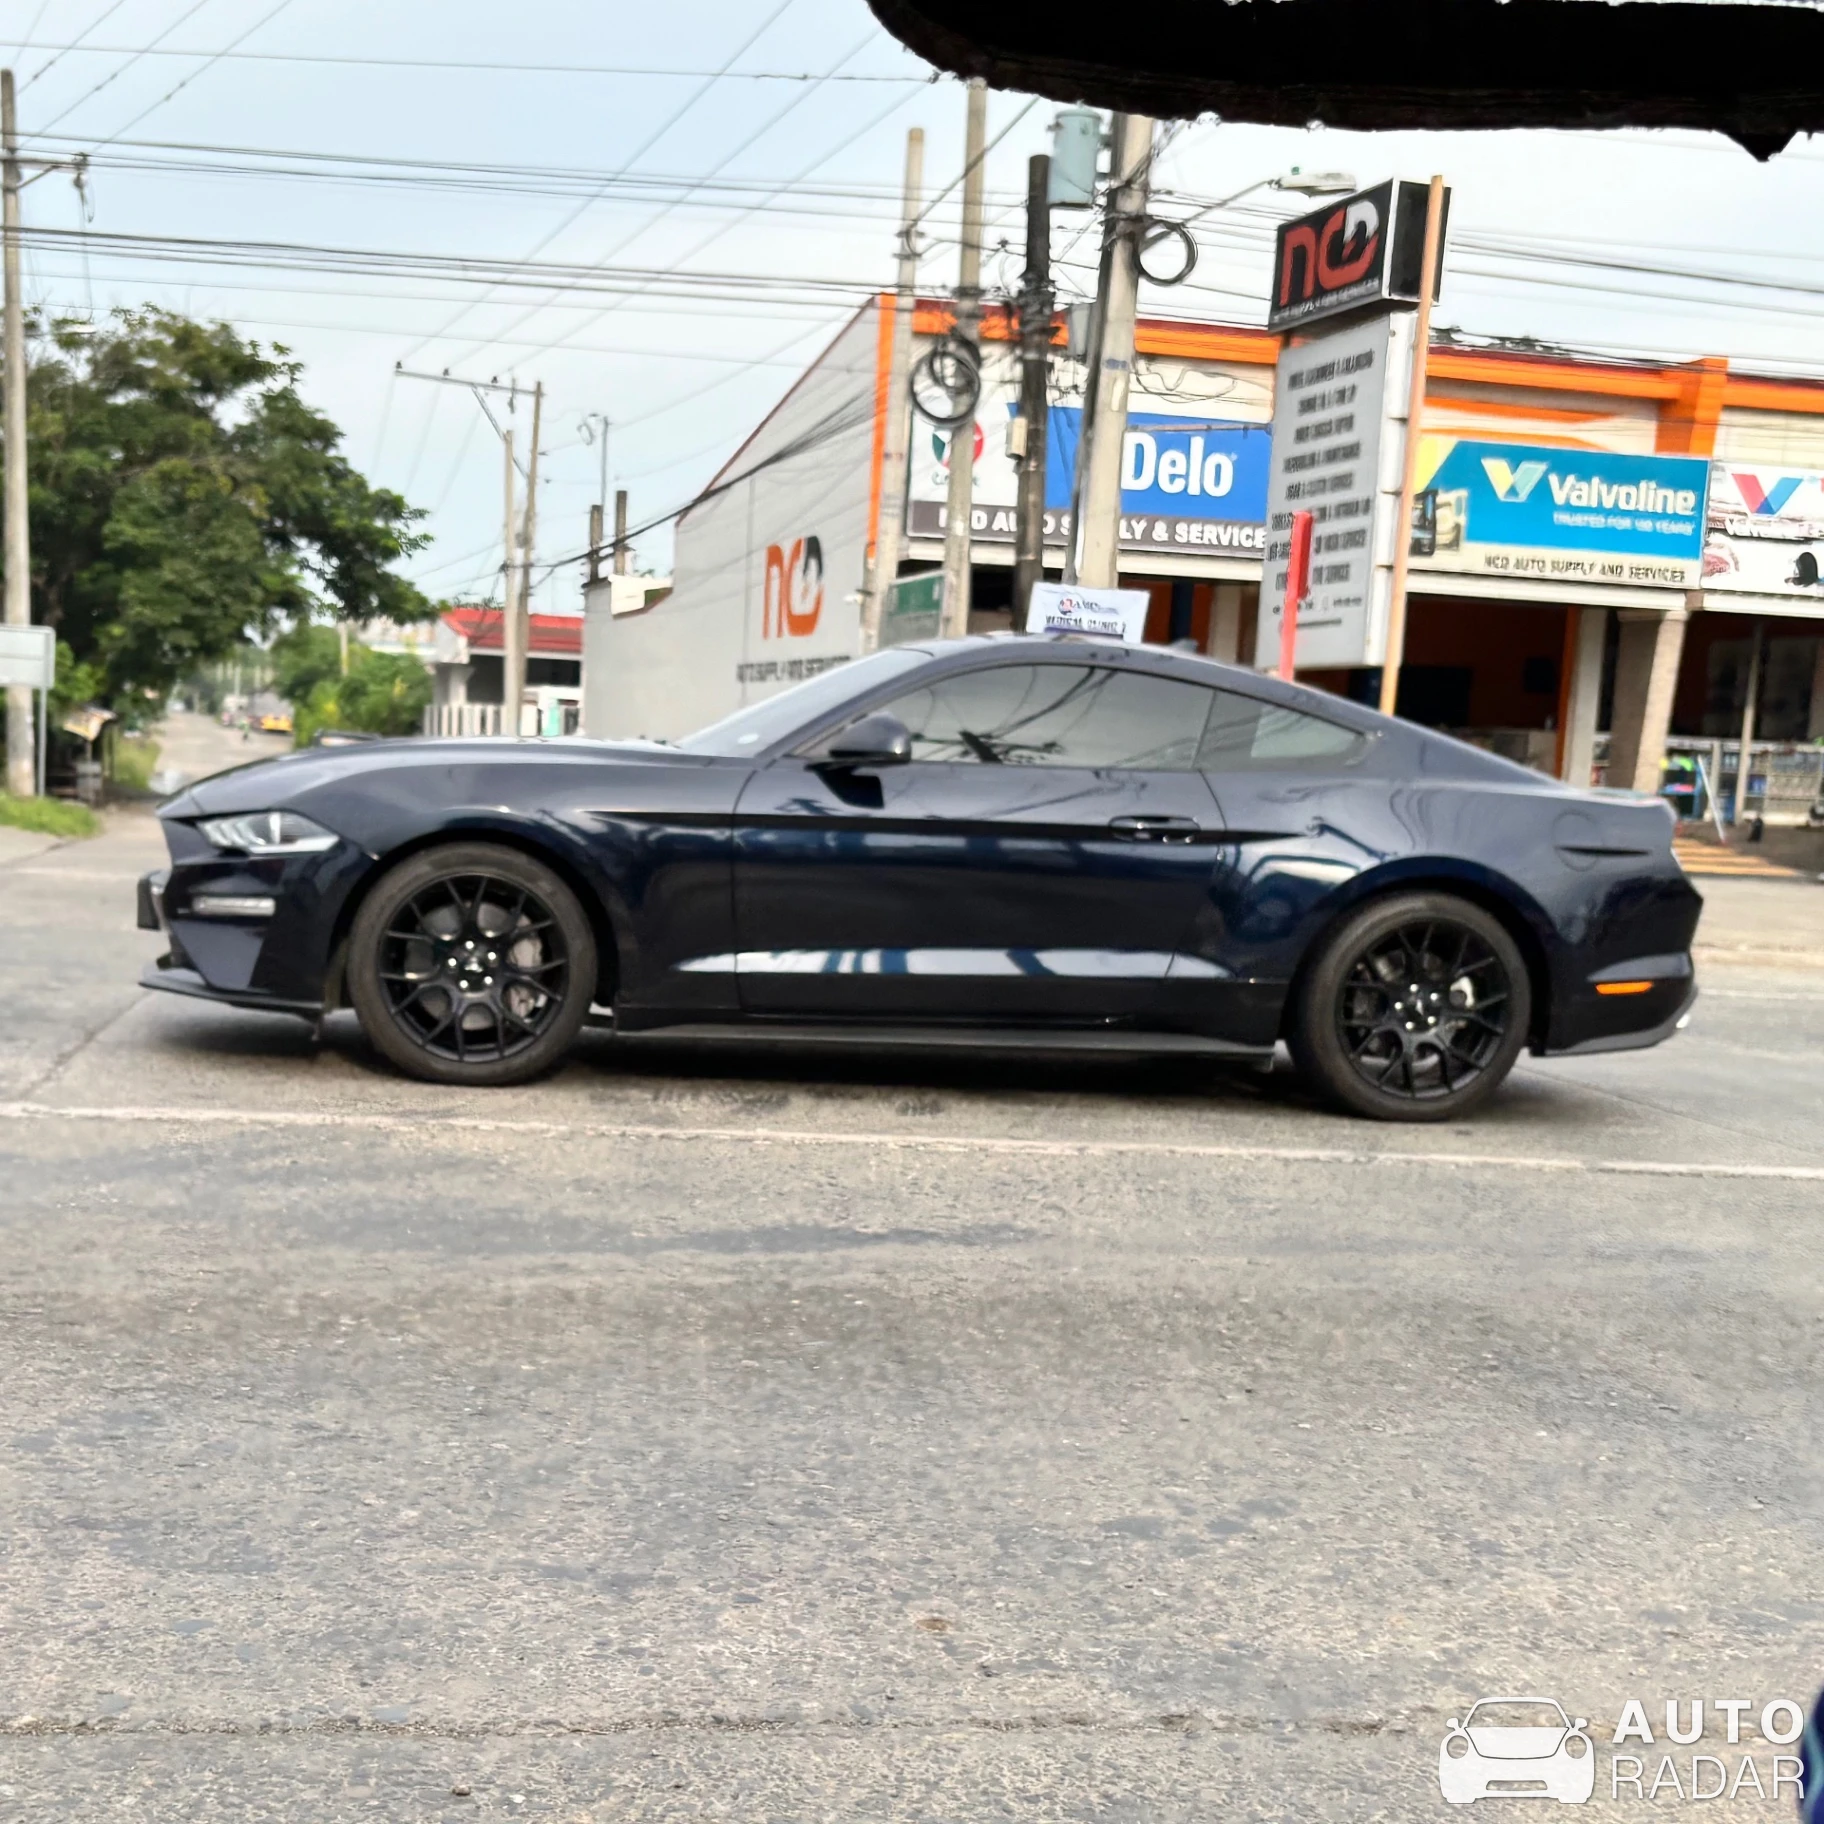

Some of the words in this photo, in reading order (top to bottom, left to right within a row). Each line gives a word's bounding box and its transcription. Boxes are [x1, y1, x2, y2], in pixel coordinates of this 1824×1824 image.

[1120, 431, 1234, 498] Delo
[1547, 473, 1697, 517] Valvoline
[1513, 557, 1546, 573] AUTO
[1550, 559, 1595, 575] SUPPLY
